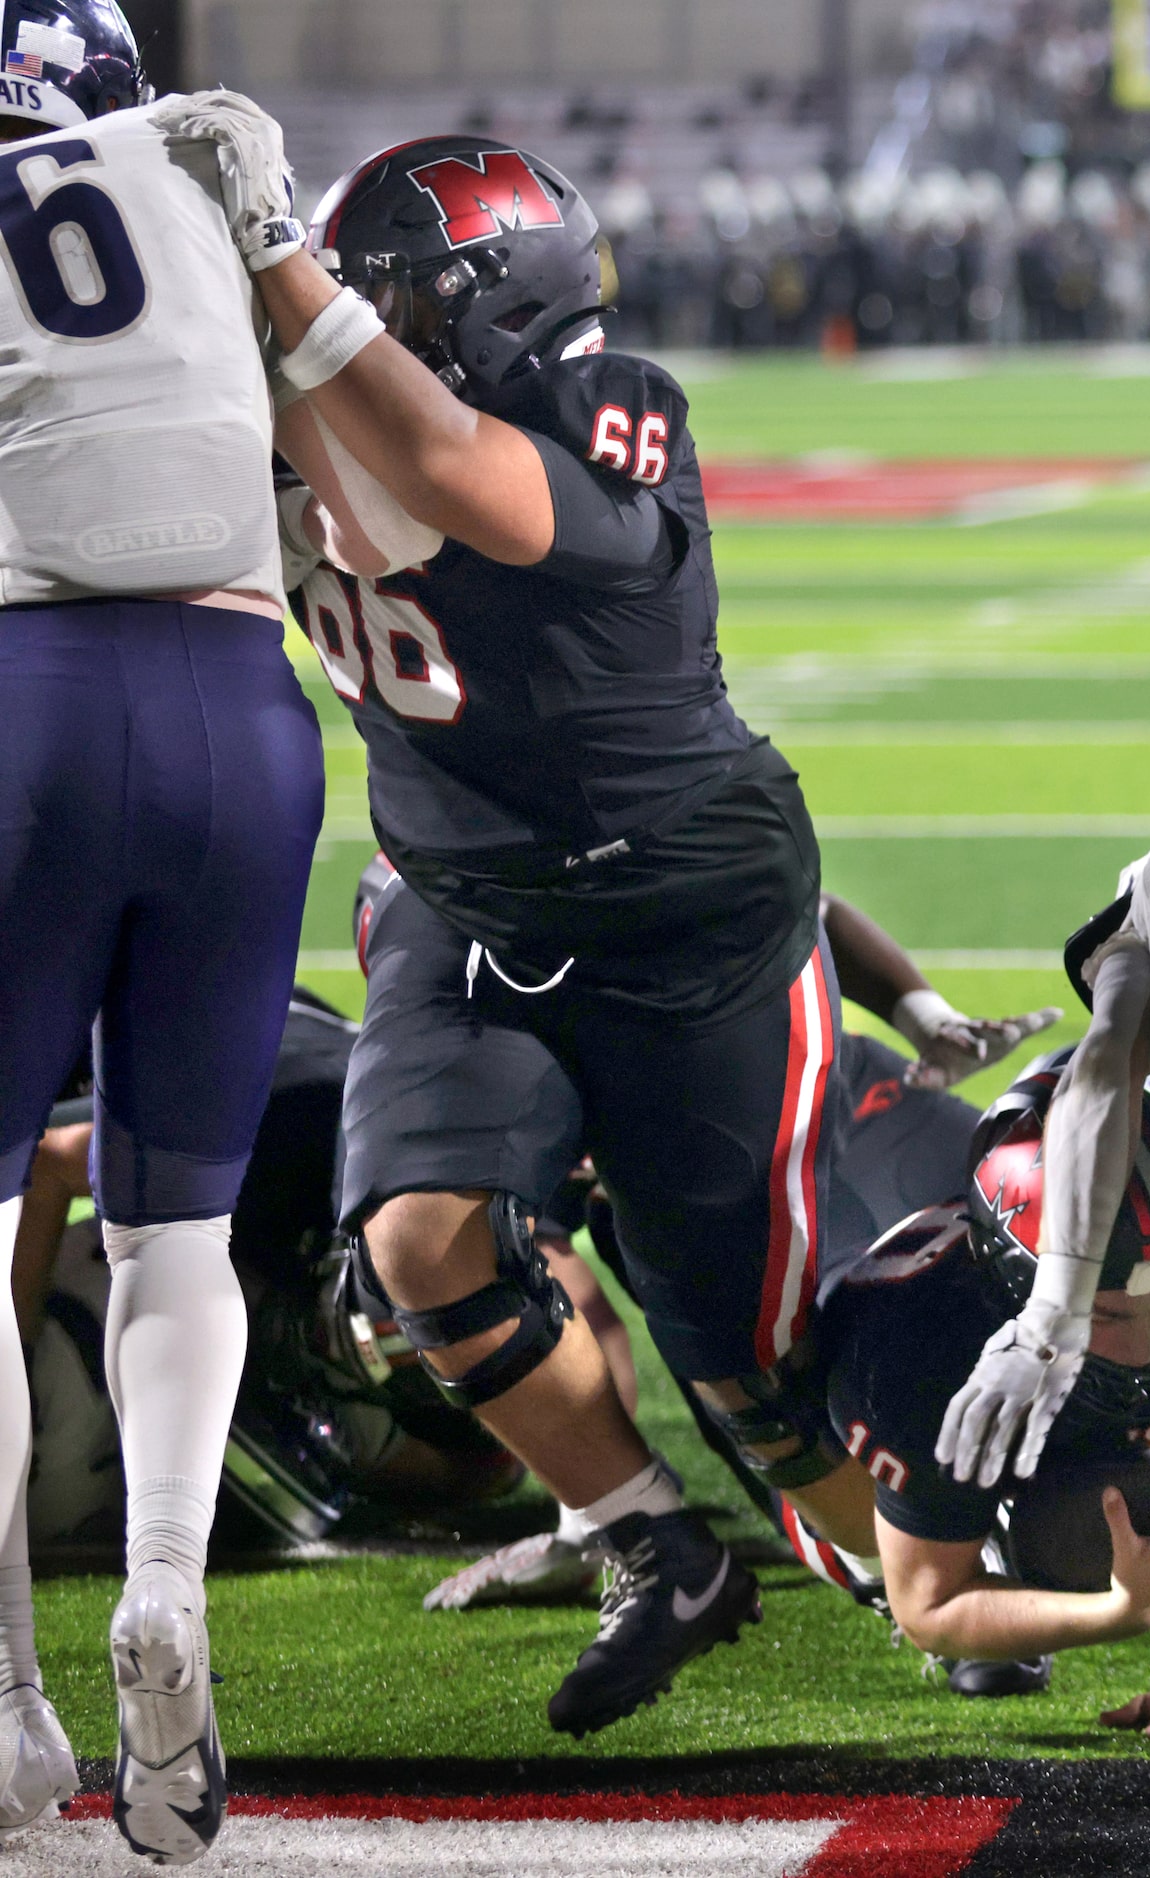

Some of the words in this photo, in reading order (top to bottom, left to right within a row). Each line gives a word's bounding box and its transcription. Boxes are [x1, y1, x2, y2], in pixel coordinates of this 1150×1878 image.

[0, 136, 153, 346] 6
[406, 150, 565, 250] M
[586, 402, 669, 488] 66
